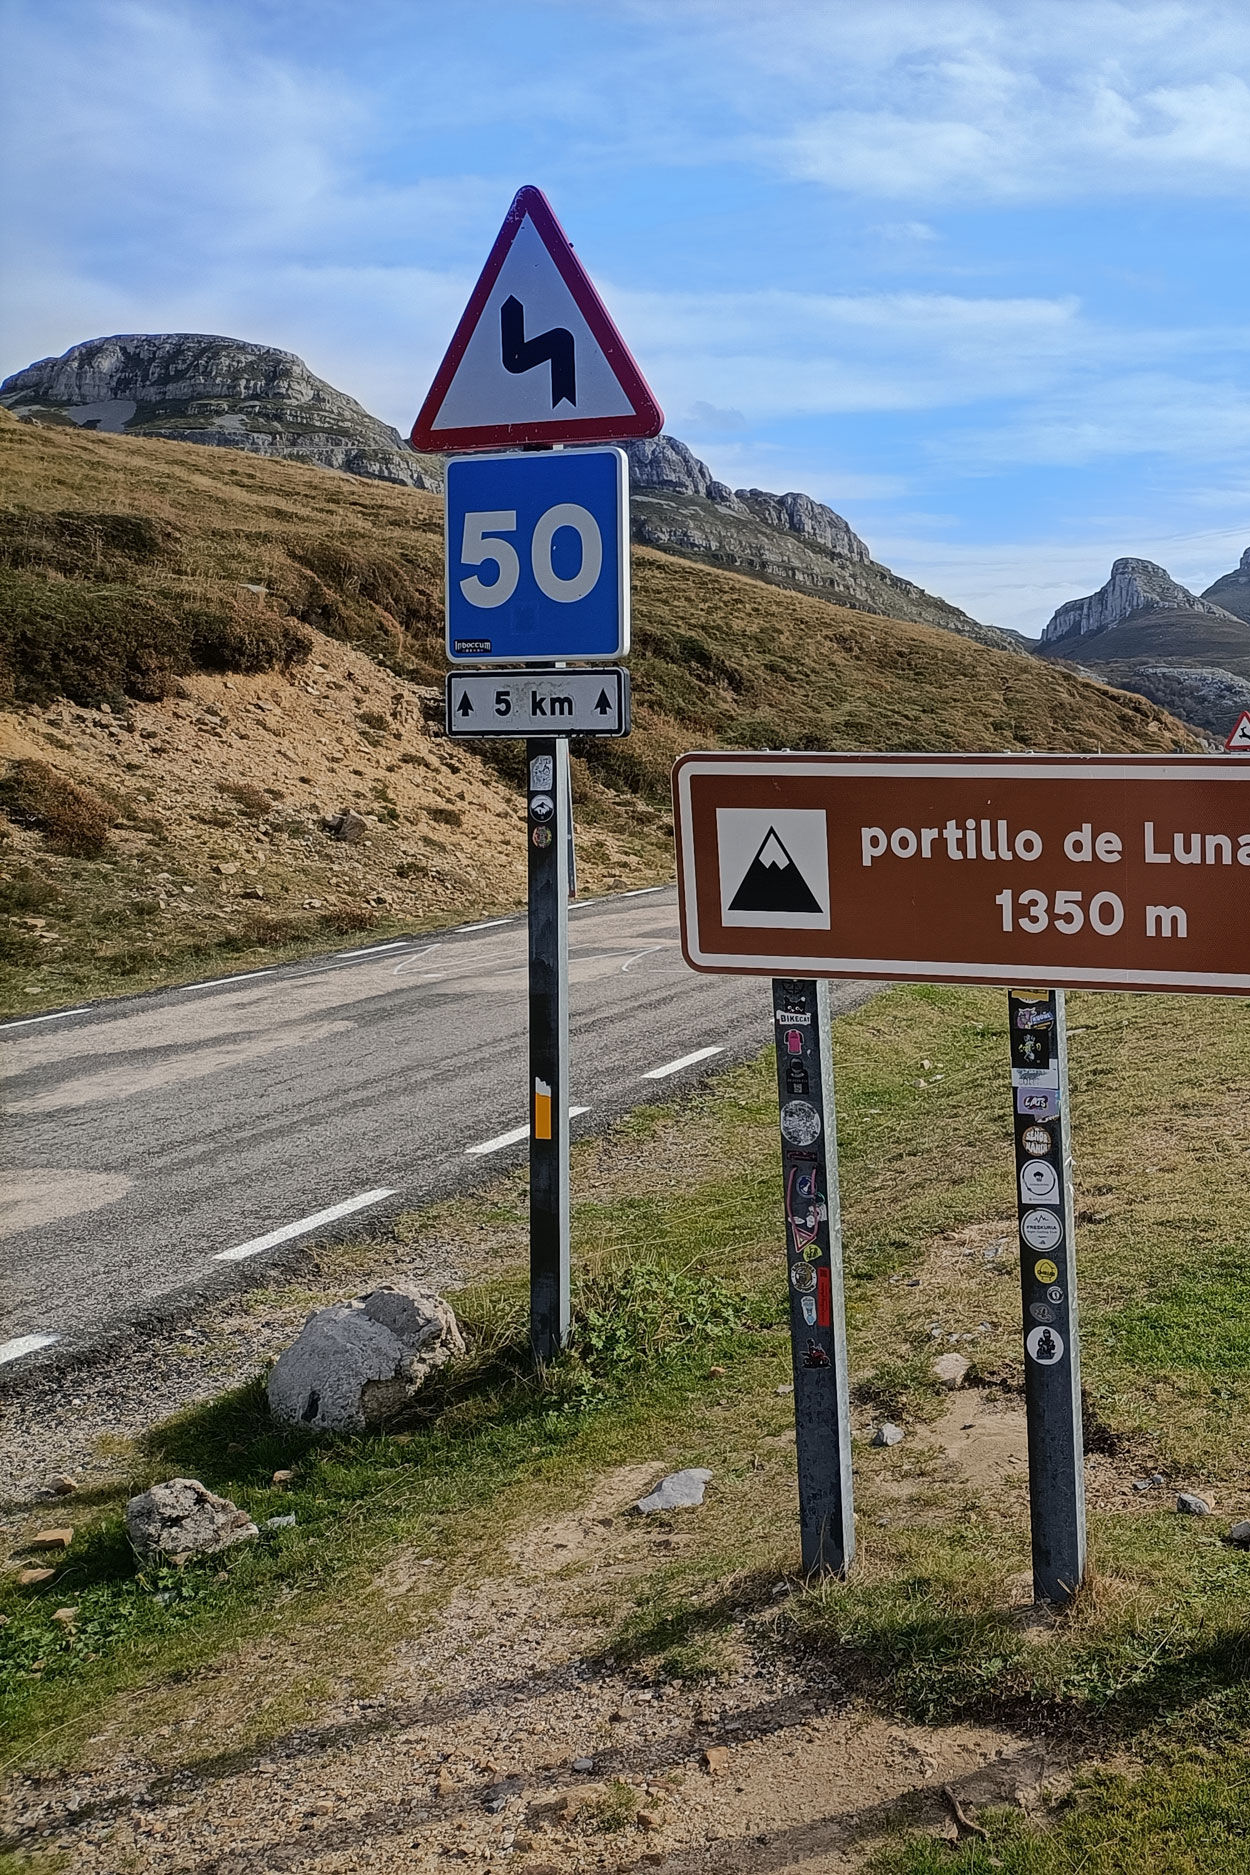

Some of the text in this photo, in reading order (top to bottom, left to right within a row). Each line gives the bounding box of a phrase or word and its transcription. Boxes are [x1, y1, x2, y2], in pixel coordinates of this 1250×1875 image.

[459, 503, 603, 609] 50
[495, 691, 573, 717] 5 km
[861, 818, 1043, 867] portillo
[1063, 823, 1122, 863] de
[995, 889, 1188, 938] 1350 m
[780, 1014, 811, 1023] BIKECAT
